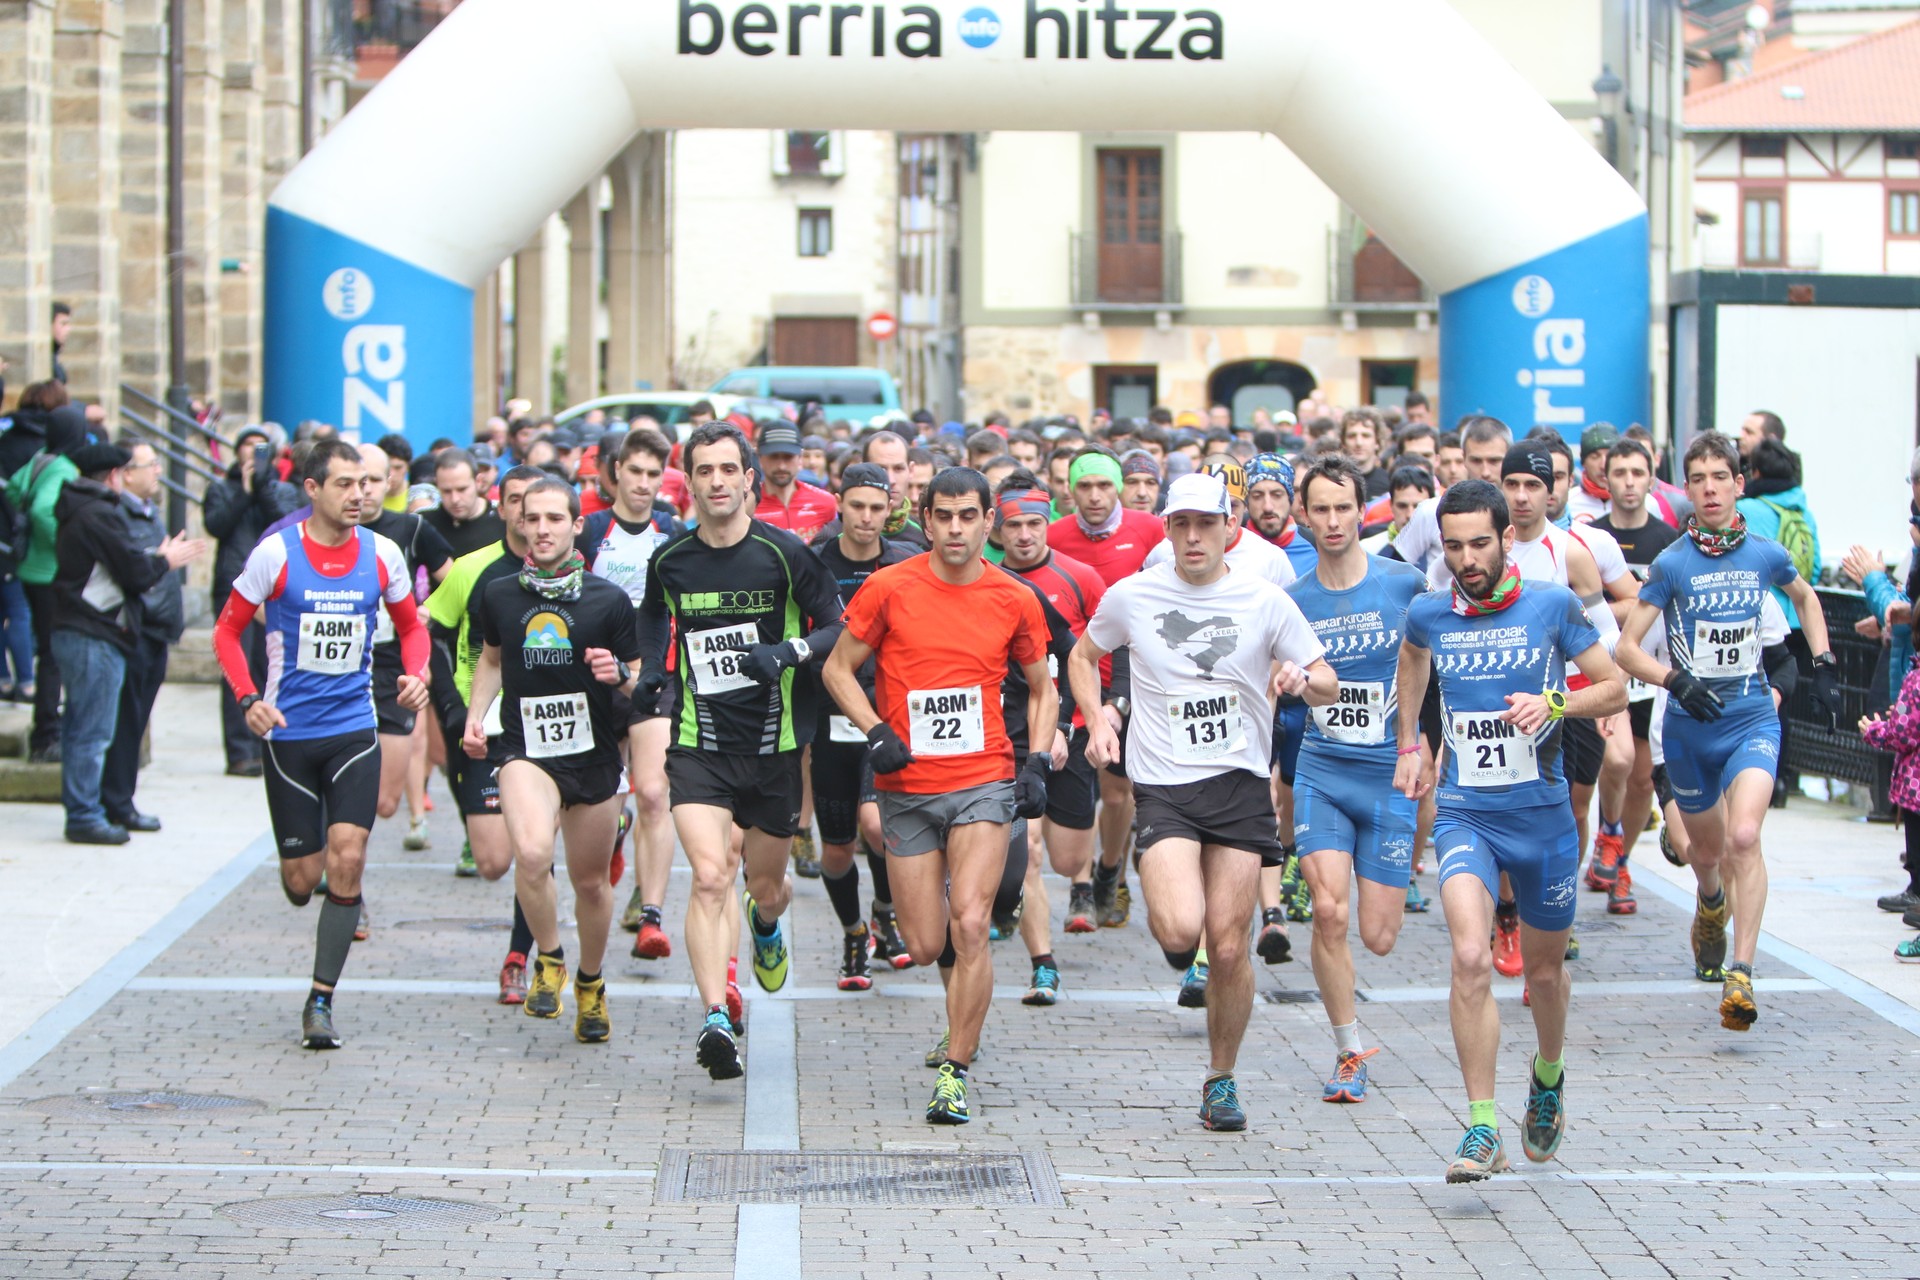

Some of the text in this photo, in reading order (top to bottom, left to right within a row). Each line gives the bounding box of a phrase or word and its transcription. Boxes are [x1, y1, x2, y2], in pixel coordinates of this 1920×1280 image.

[678, 0, 942, 57] berria
[1023, 0, 1225, 60] hitza
[343, 324, 406, 446] za
[1516, 319, 1585, 440] ria
[304, 589, 364, 600] Dantzaleku
[720, 590, 774, 609] 2015
[314, 601, 354, 611] Sakana
[313, 620, 353, 638] A8M
[1708, 627, 1745, 645] A8M
[312, 640, 352, 660] 167
[704, 631, 745, 654] A8M
[1714, 648, 1740, 666] 19
[923, 693, 967, 715] A8M
[1336, 687, 1369, 705] 8M
[534, 700, 575, 720] A8M
[1183, 695, 1228, 720] A8M
[1326, 707, 1370, 728] 266
[536, 720, 576, 743] 137
[932, 717, 962, 740] 22
[1185, 718, 1228, 746] 131
[1467, 719, 1515, 740] A8M
[1476, 744, 1506, 768] 21
